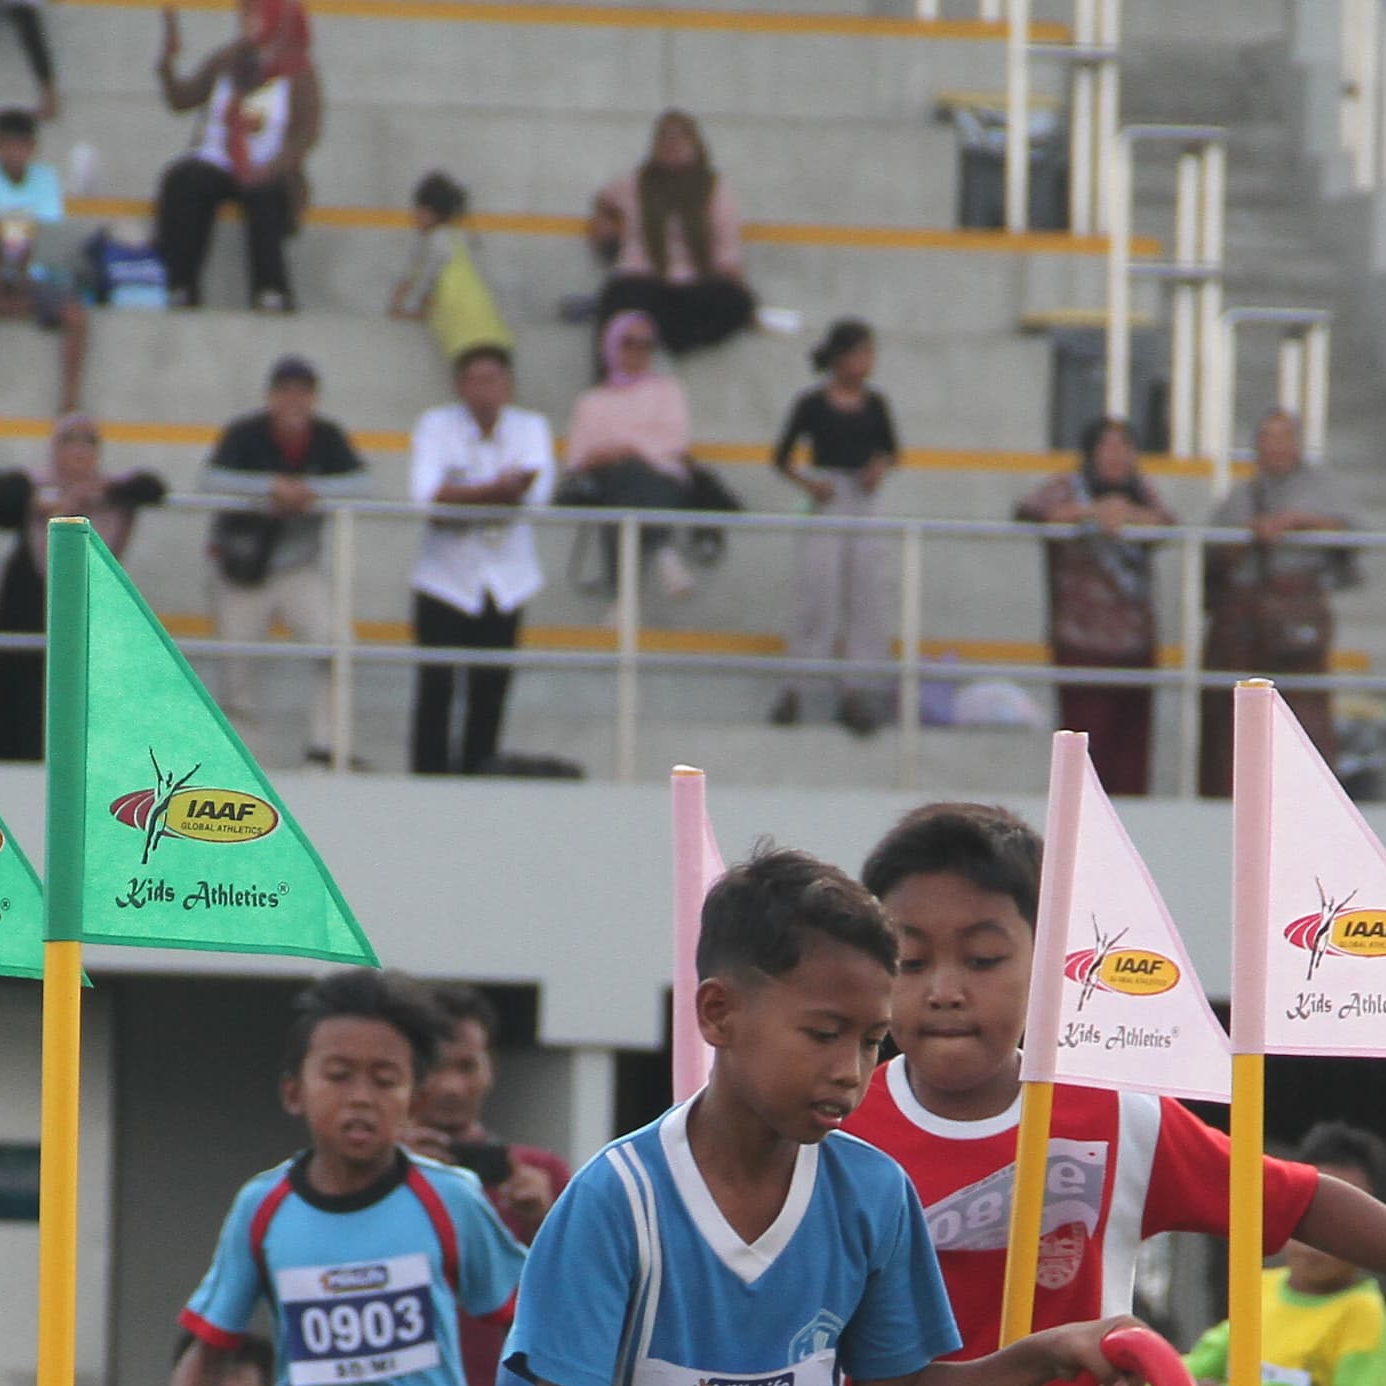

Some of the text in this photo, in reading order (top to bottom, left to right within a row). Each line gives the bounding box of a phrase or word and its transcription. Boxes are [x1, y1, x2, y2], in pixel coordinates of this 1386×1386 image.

[186, 799, 256, 821] IAAF
[180, 822, 263, 835] GLOBAL ATHLETICS
[115, 877, 176, 909] Kids
[1115, 957, 1165, 975] IAAF
[1286, 992, 1332, 1020] Kids
[1057, 1022, 1101, 1049] Kids
[301, 1296, 425, 1354] 0903
